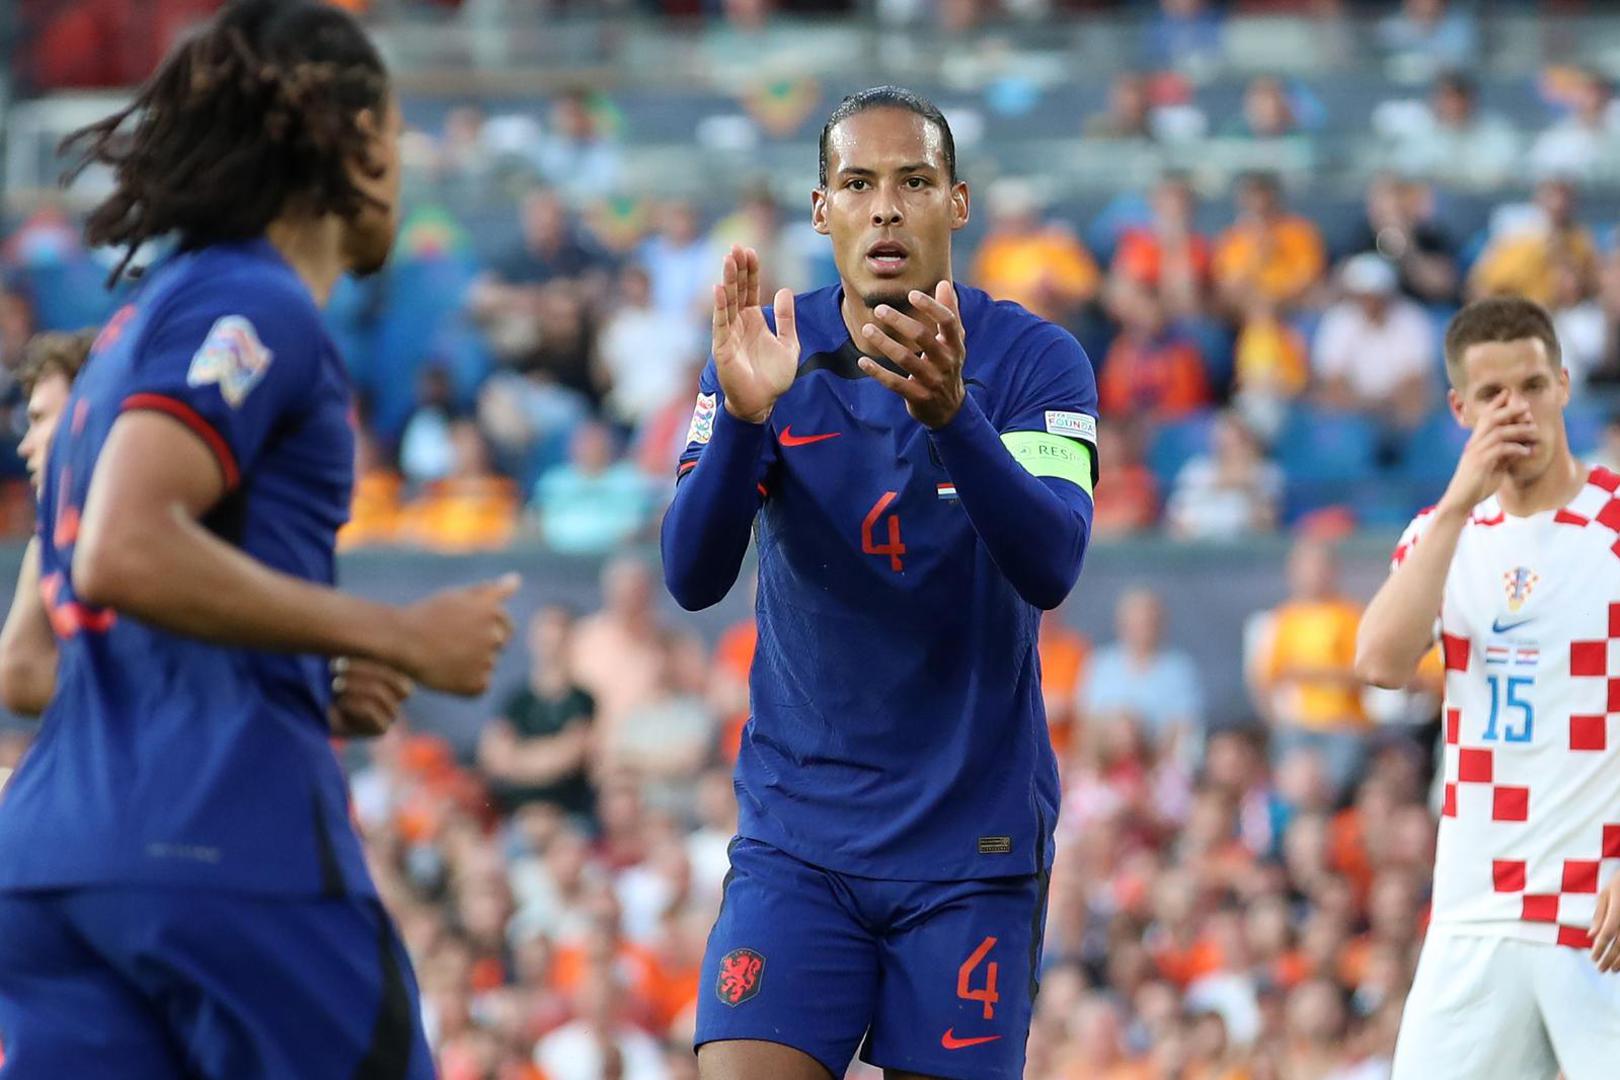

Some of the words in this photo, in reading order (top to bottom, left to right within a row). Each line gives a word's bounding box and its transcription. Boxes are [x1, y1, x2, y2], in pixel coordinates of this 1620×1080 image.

[862, 490, 906, 572] 4
[1482, 674, 1535, 743] 15
[957, 936, 999, 1019] 4
